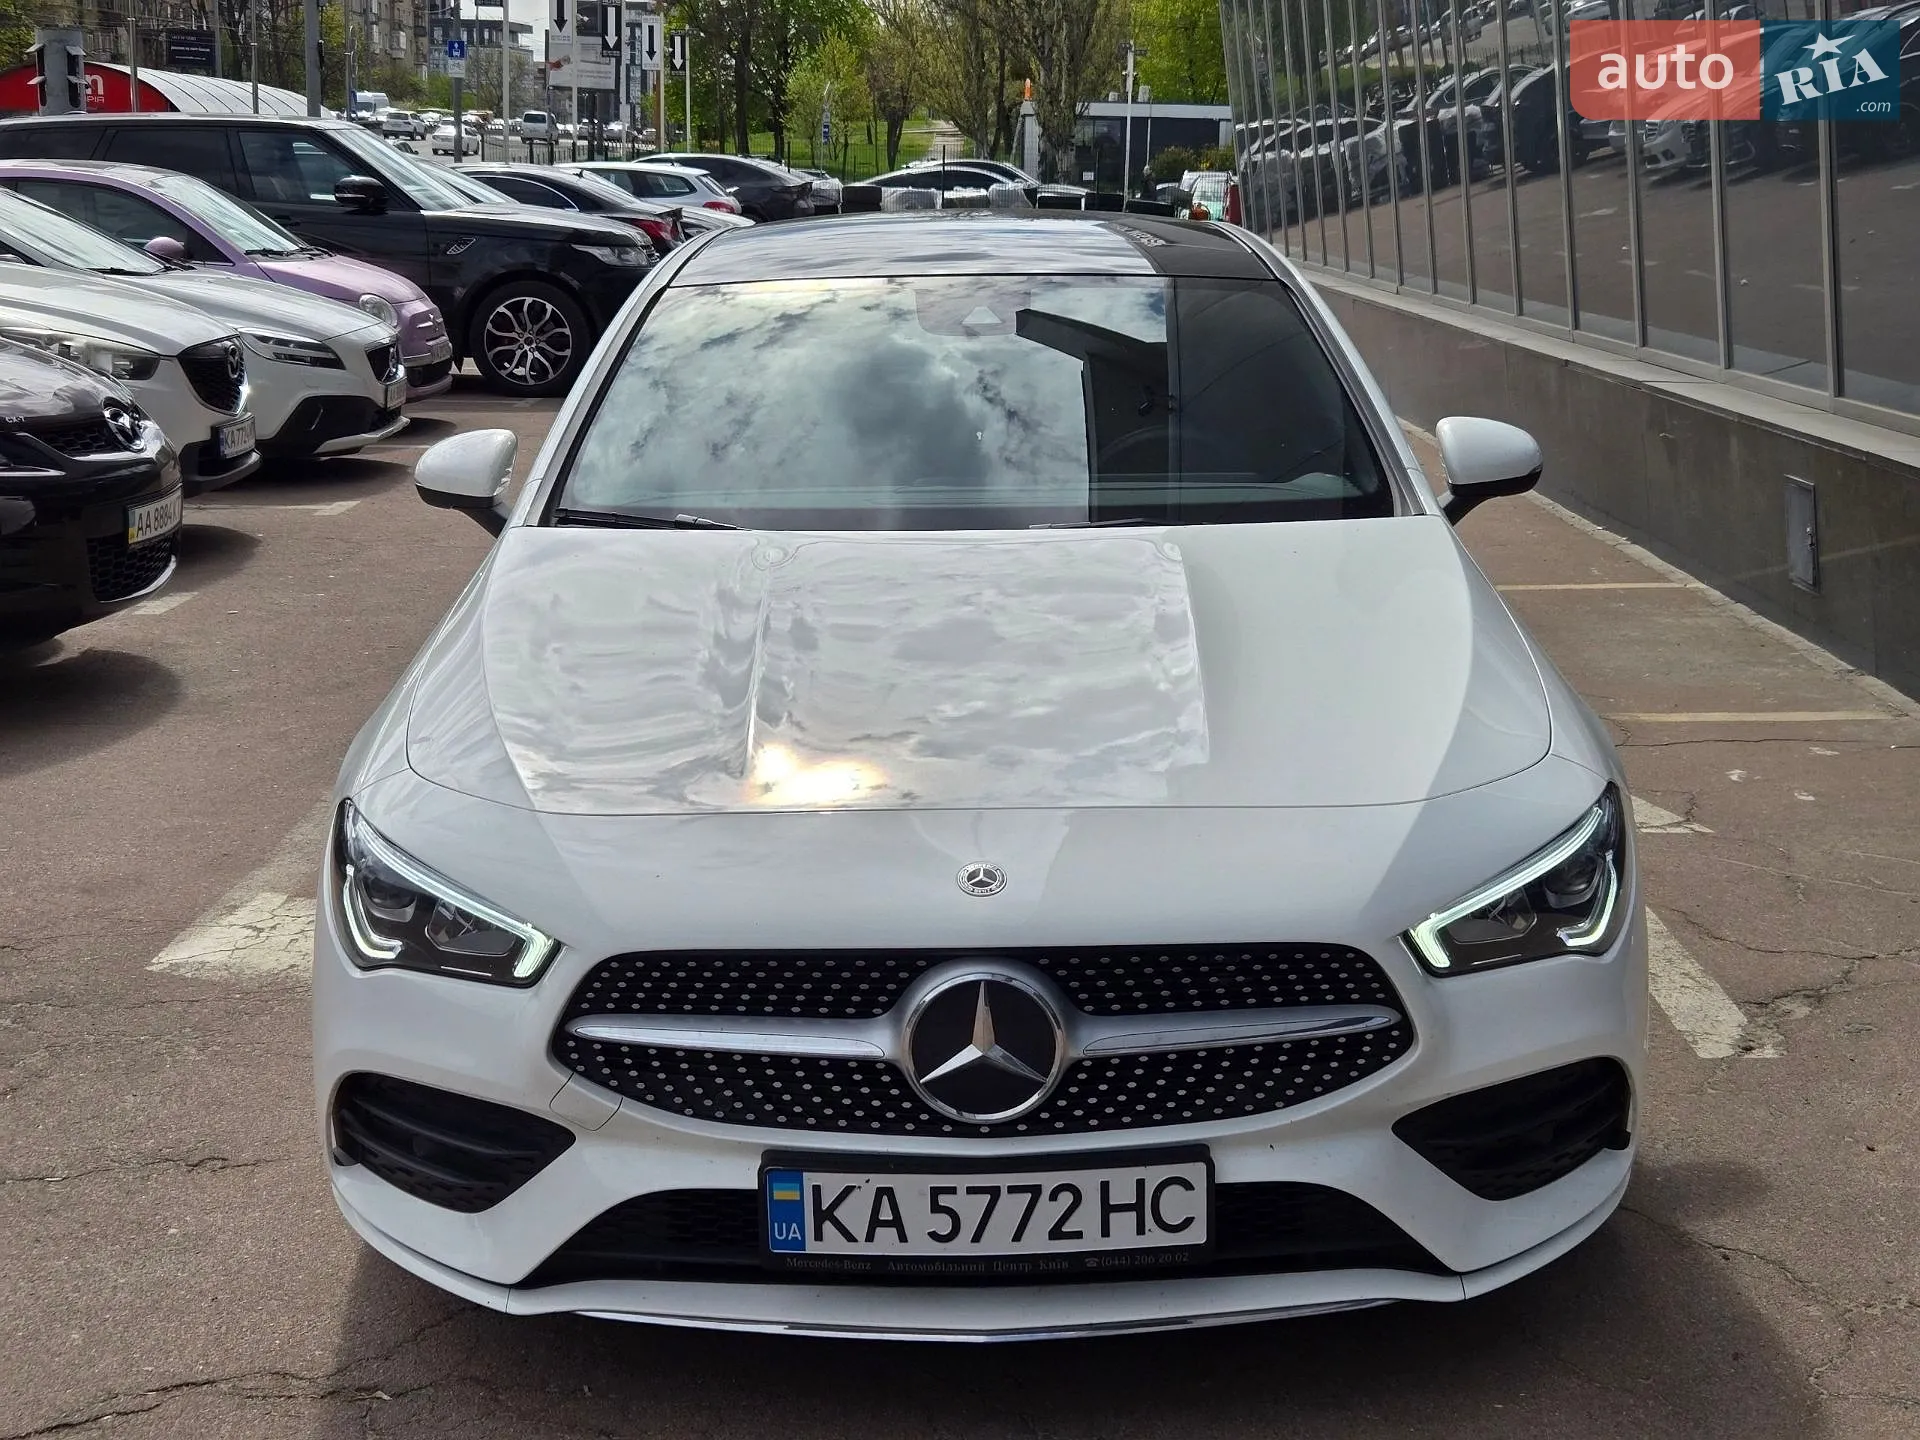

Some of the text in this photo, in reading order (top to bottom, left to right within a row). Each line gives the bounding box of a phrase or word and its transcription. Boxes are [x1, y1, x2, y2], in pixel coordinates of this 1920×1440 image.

[136, 510, 152, 538] AA
[810, 1176, 1197, 1244] KA 5772 HC
[773, 1222, 802, 1241] UA
[785, 1257, 872, 1271] Mercedes-Benz
[993, 1260, 1033, 1274] Центр
[1159, 1253, 1173, 1264] 20
[1175, 1252, 1190, 1263] 02
